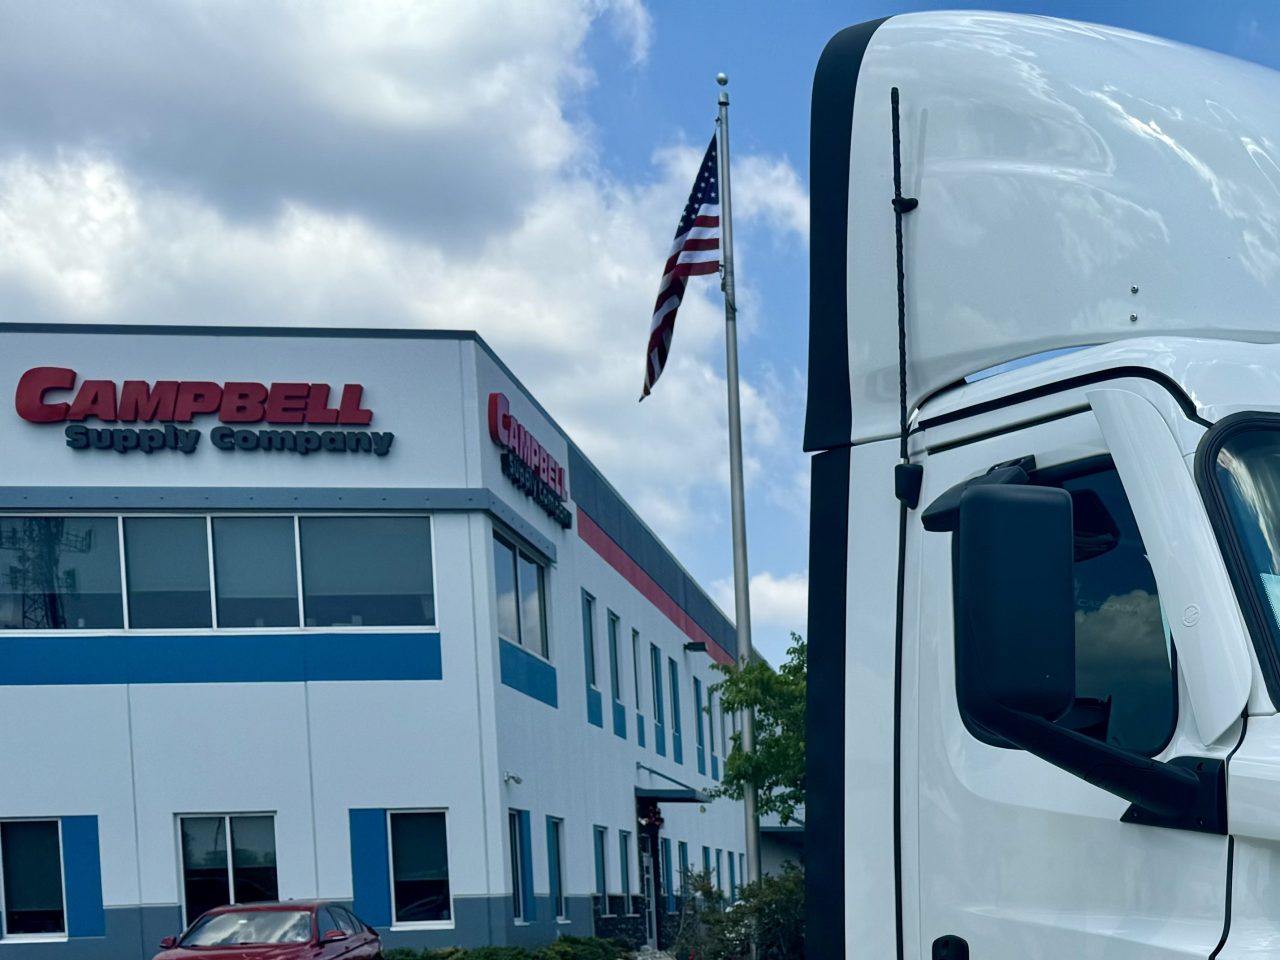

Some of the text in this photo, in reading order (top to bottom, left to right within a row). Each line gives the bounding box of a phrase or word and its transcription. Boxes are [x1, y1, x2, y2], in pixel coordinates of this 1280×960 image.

[15, 366, 374, 426] CAMPBELL
[65, 424, 396, 456] Supply Company
[488, 392, 568, 502] CAMPBELL
